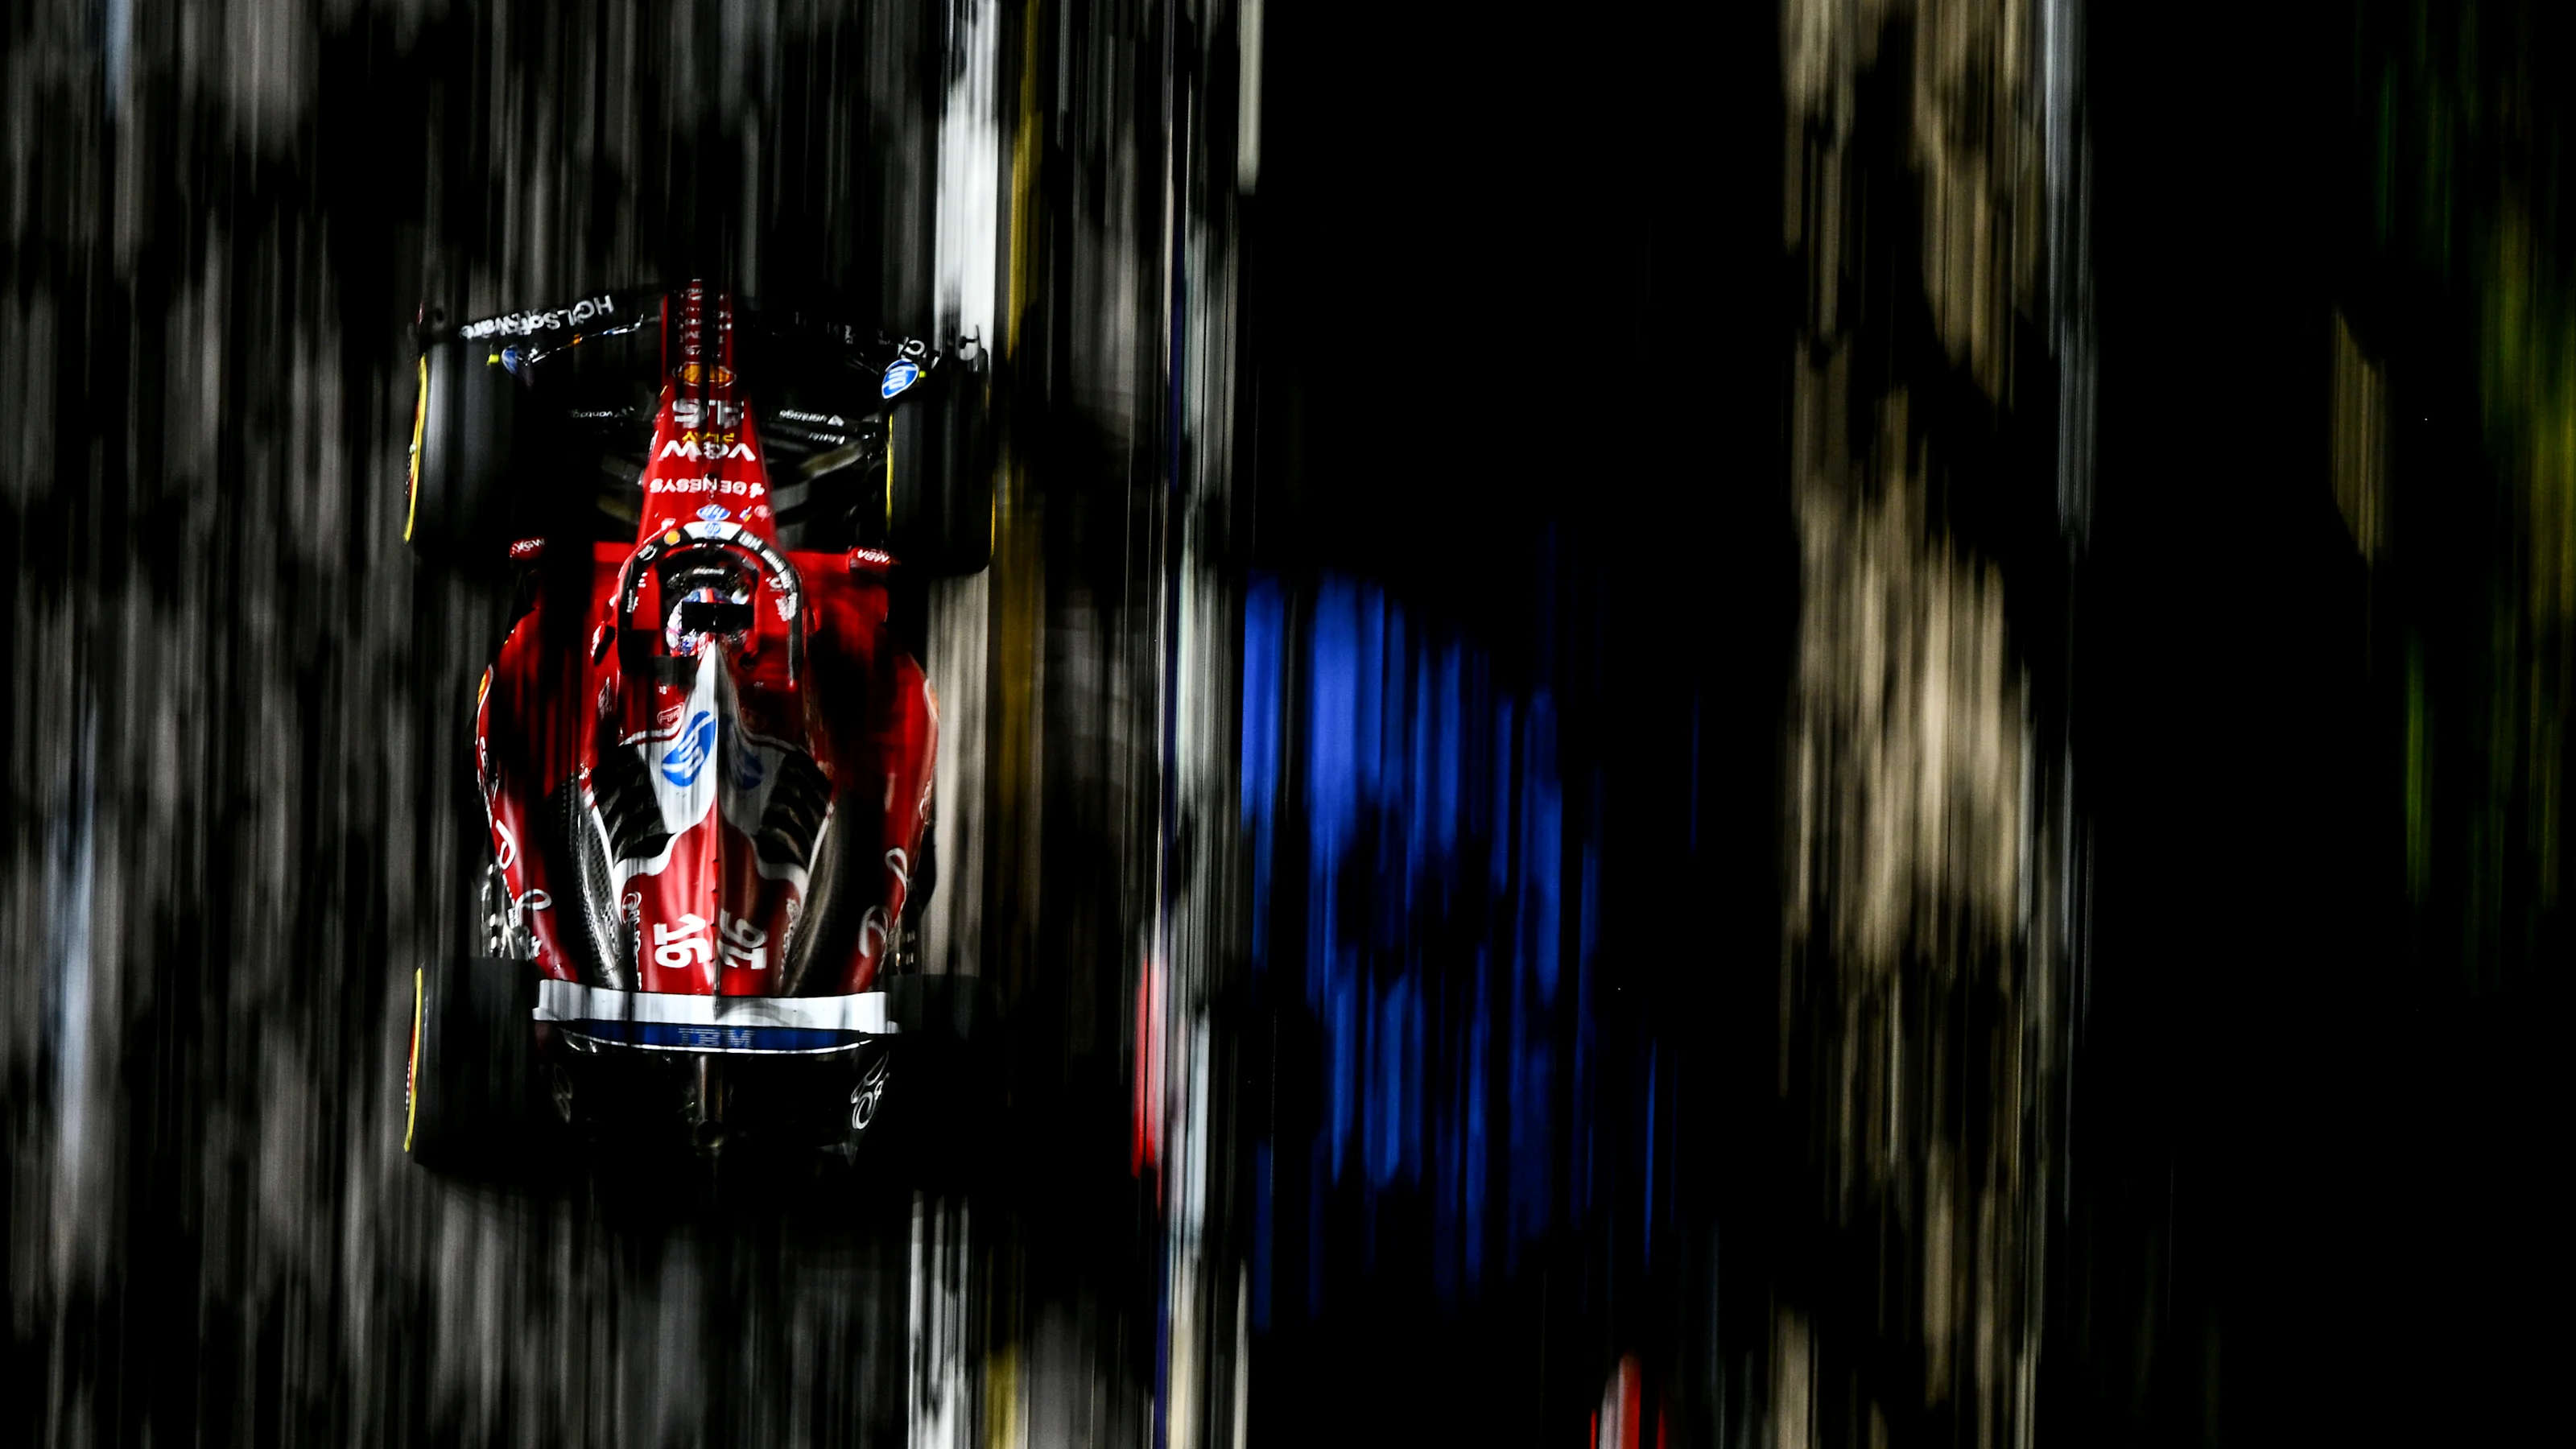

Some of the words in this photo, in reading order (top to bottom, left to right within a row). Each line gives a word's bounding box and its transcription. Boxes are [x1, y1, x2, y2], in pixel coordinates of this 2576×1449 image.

[649, 477, 747, 494] GENESYS
[653, 913, 711, 968] 16
[717, 908, 769, 970] 16
[677, 1028, 757, 1049] IBM
